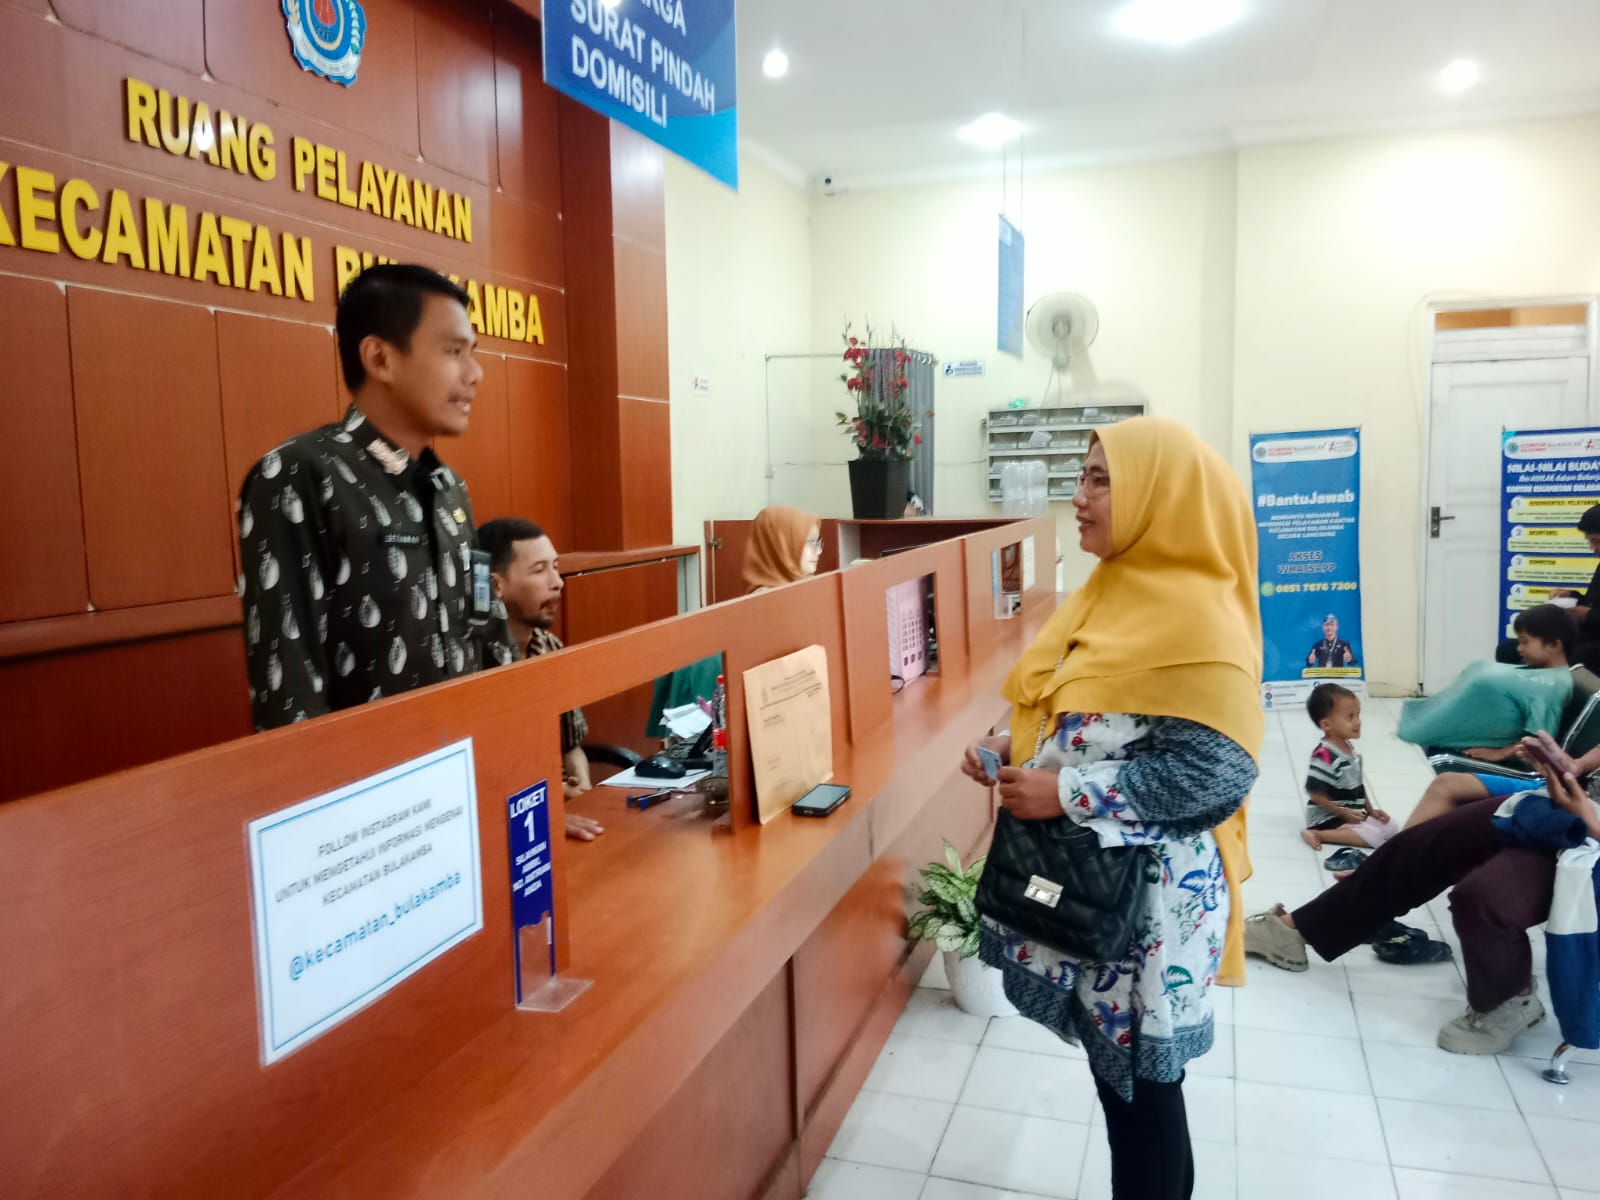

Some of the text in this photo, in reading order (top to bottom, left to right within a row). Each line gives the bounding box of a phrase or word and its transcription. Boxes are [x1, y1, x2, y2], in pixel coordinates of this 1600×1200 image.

[571, 0, 646, 63] SURAT
[651, 37, 715, 116] PINDAH
[571, 36, 667, 128] DOMISILI
[126, 77, 472, 243] RUANG PELAYANAN
[1568, 460, 1600, 471] BUDA
[1257, 489, 1355, 507] #BantuJawab
[1516, 528, 1522, 536] 2
[1277, 562, 1337, 574] WHATSAPP
[1288, 551, 1323, 561] AKSES
[1515, 585, 1521, 593] 4
[509, 786, 546, 819] LOKET
[318, 831, 359, 857] FOLLOW
[361, 807, 411, 839] INSTAGRAM
[523, 810, 535, 842] 1
[275, 876, 312, 904] UNTUK
[313, 848, 377, 886] MENGETAHUI
[378, 825, 423, 855] INFORMASI
[323, 842, 433, 906] KECAMATAN BULAKAMBA
[289, 870, 461, 981] @kecamatan_bulakamba
